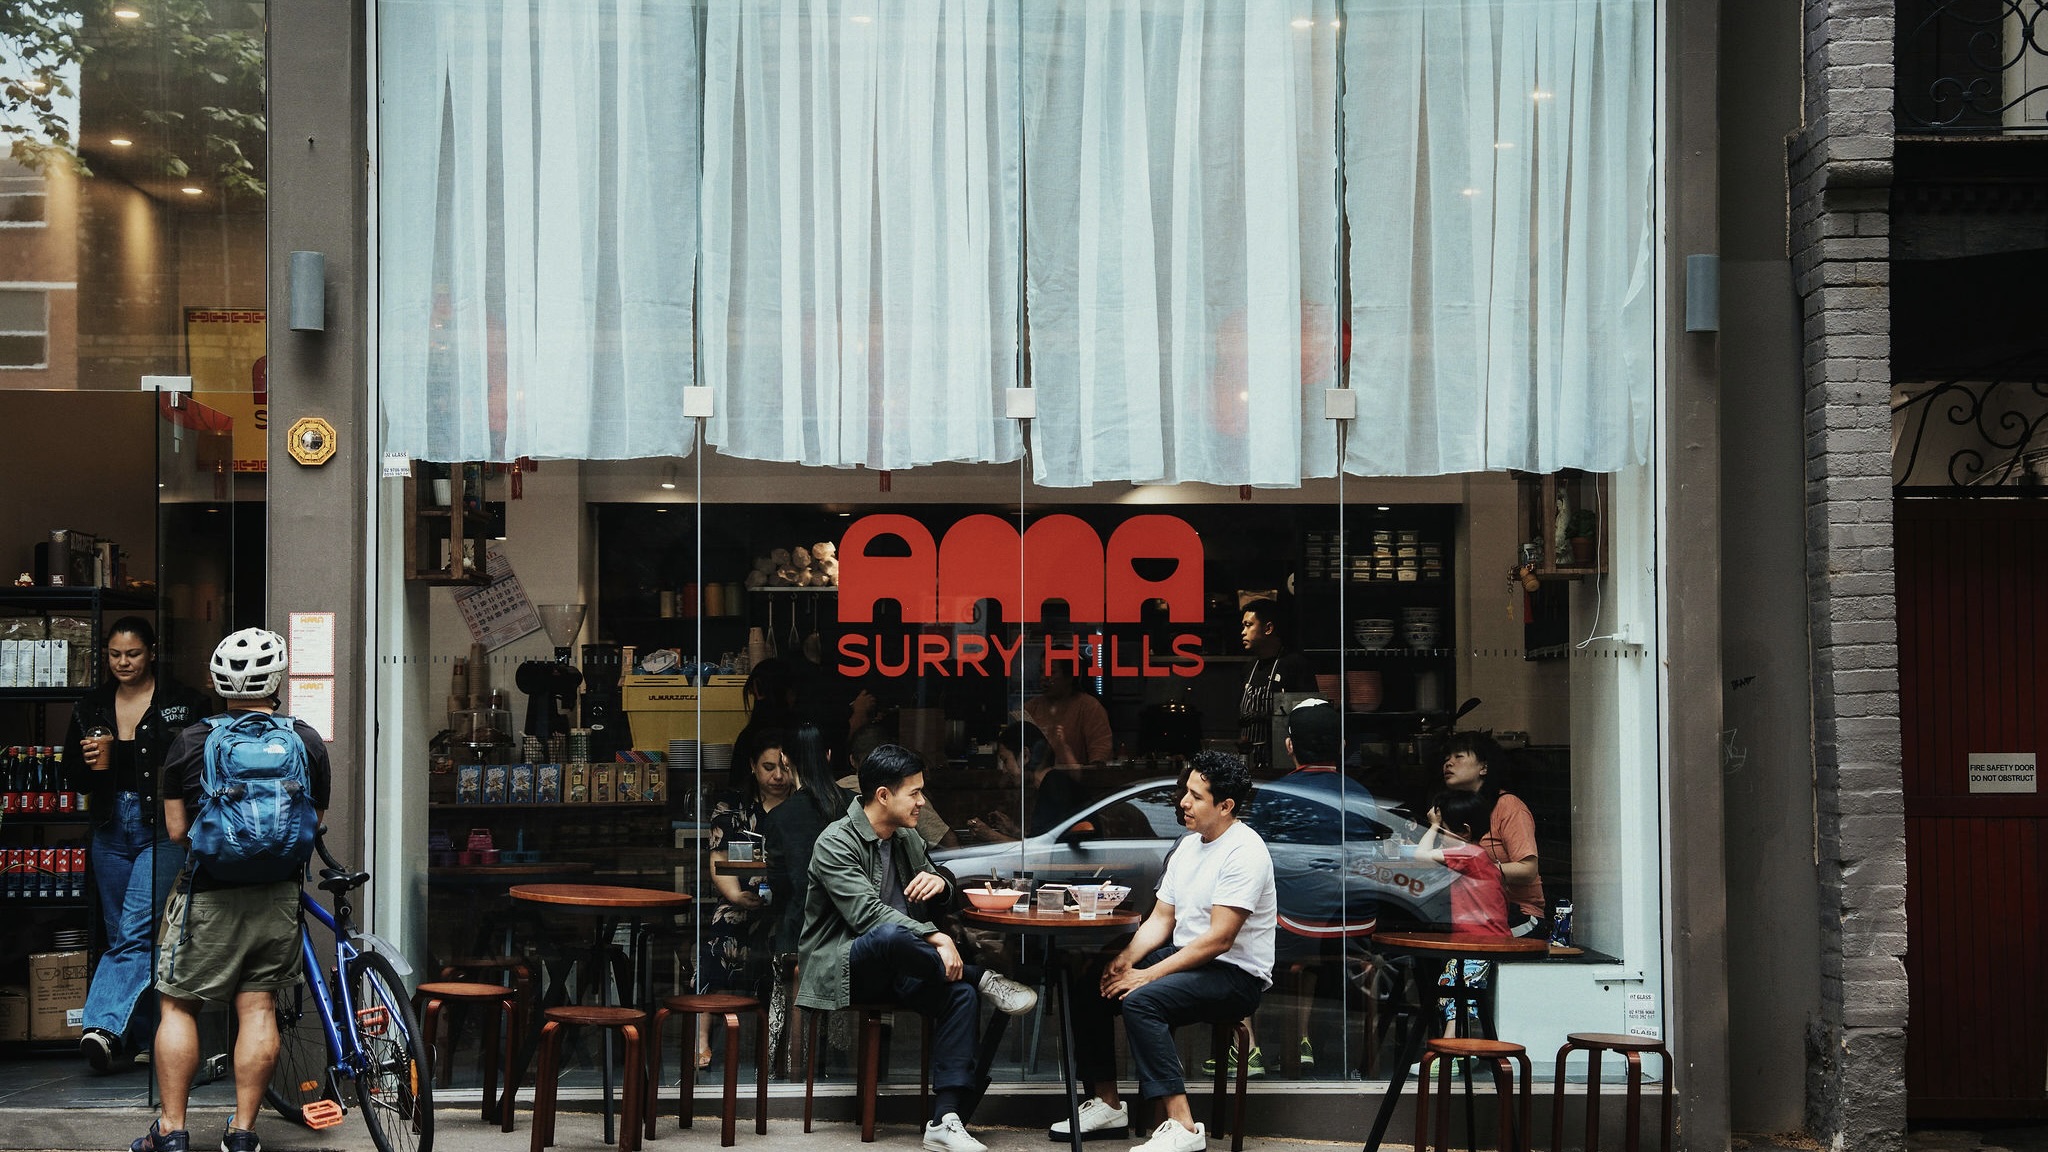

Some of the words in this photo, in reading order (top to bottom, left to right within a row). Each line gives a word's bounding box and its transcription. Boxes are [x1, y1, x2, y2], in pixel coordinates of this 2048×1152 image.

[838, 514, 1205, 623] AMA
[838, 634, 1024, 677] SURRY
[1045, 634, 1205, 677] HILLS
[1971, 774, 1981, 782] DO
[1982, 774, 1997, 782] NOT
[1997, 774, 2034, 782] OBSTRUCT
